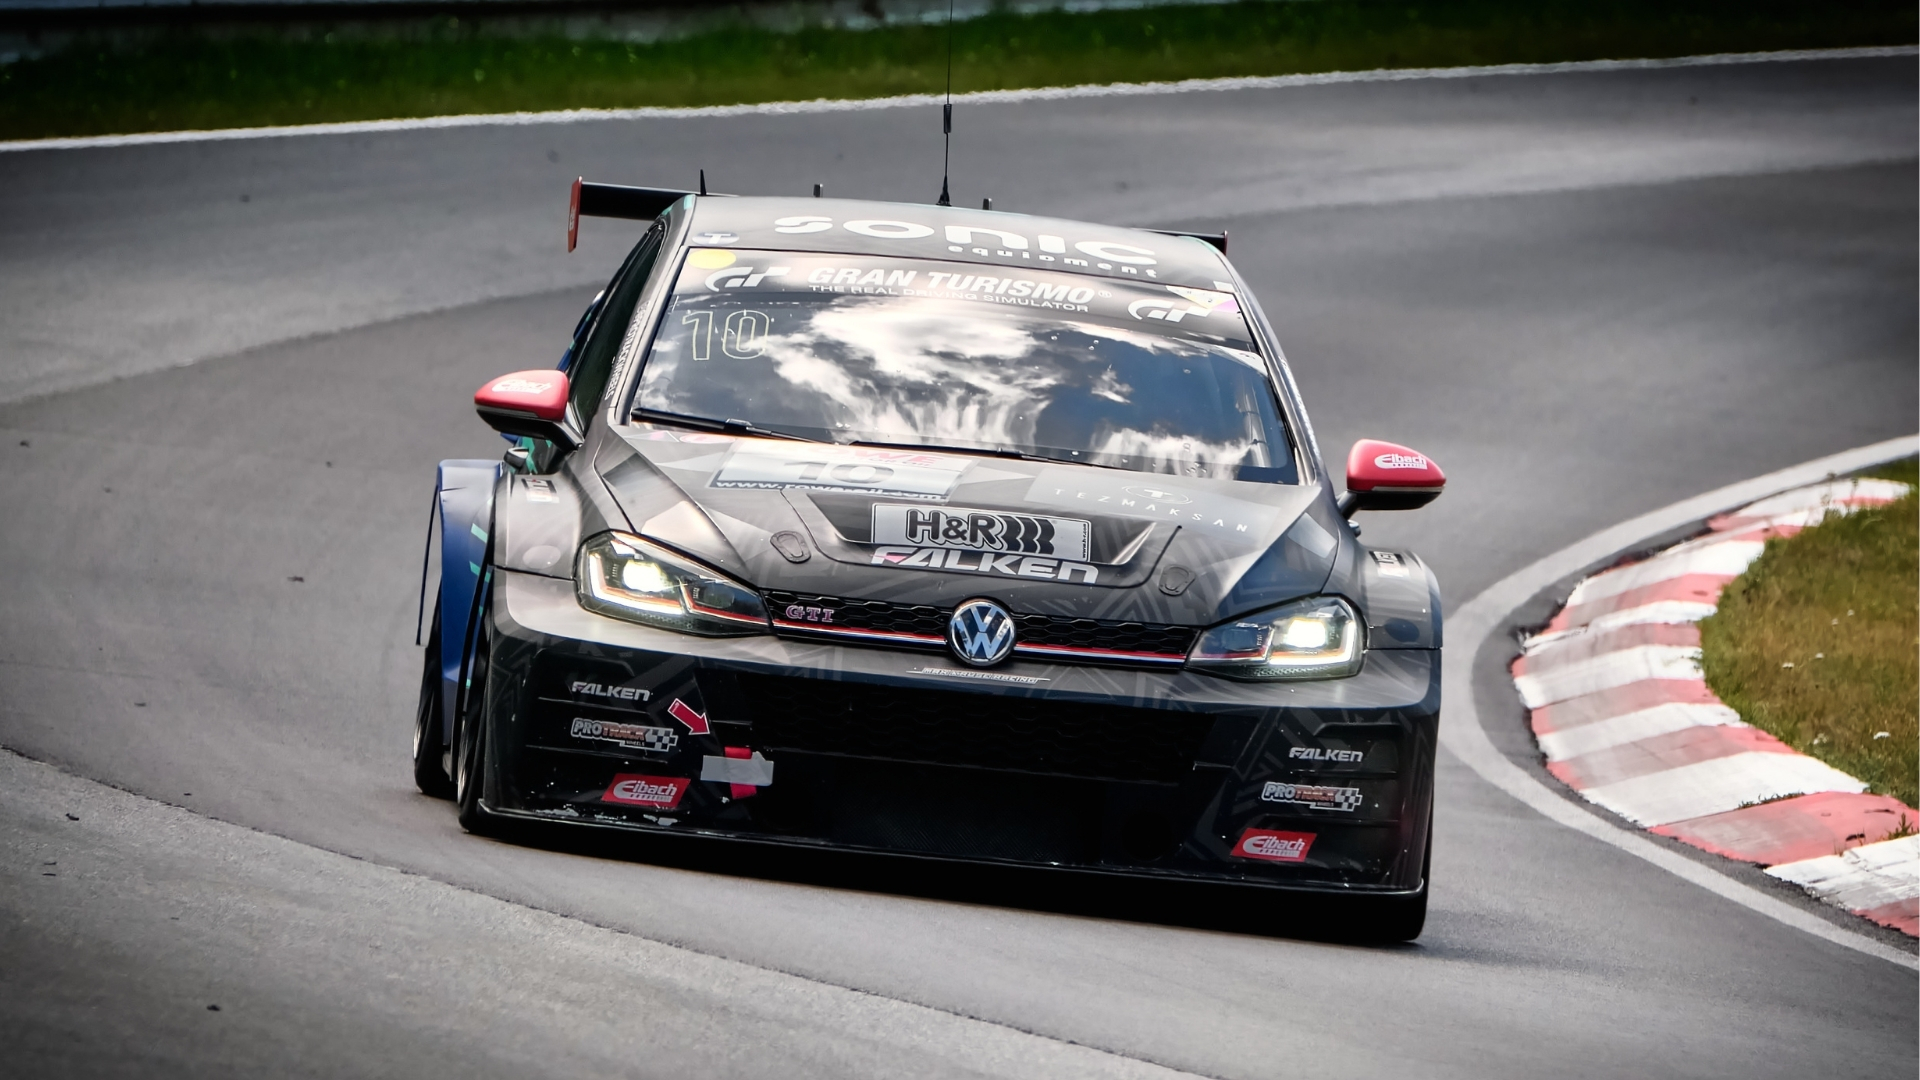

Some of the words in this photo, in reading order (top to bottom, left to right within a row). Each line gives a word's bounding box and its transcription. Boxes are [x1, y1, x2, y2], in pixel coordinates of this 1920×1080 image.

[775, 216, 1157, 265] sonic
[948, 245, 1157, 278] equipment
[807, 267, 917, 287] GRAN
[809, 285, 845, 293] THE
[851, 286, 898, 295] REAL
[903, 288, 977, 300] DRIVING
[983, 294, 1089, 312] SIMULATOR
[682, 310, 770, 361] 10
[784, 460, 895, 484] 10
[1374, 454, 1427, 470] Eibach
[1053, 488, 1248, 533] TEZMAKSAN
[906, 509, 1003, 549] H&R
[870, 546, 1099, 584] FALKEN
[785, 605, 834, 622] GTI
[572, 681, 650, 701] FALKEN
[1288, 747, 1363, 762] FALKEN
[613, 780, 677, 801] Eibach
[1243, 836, 1305, 857] Eibach
